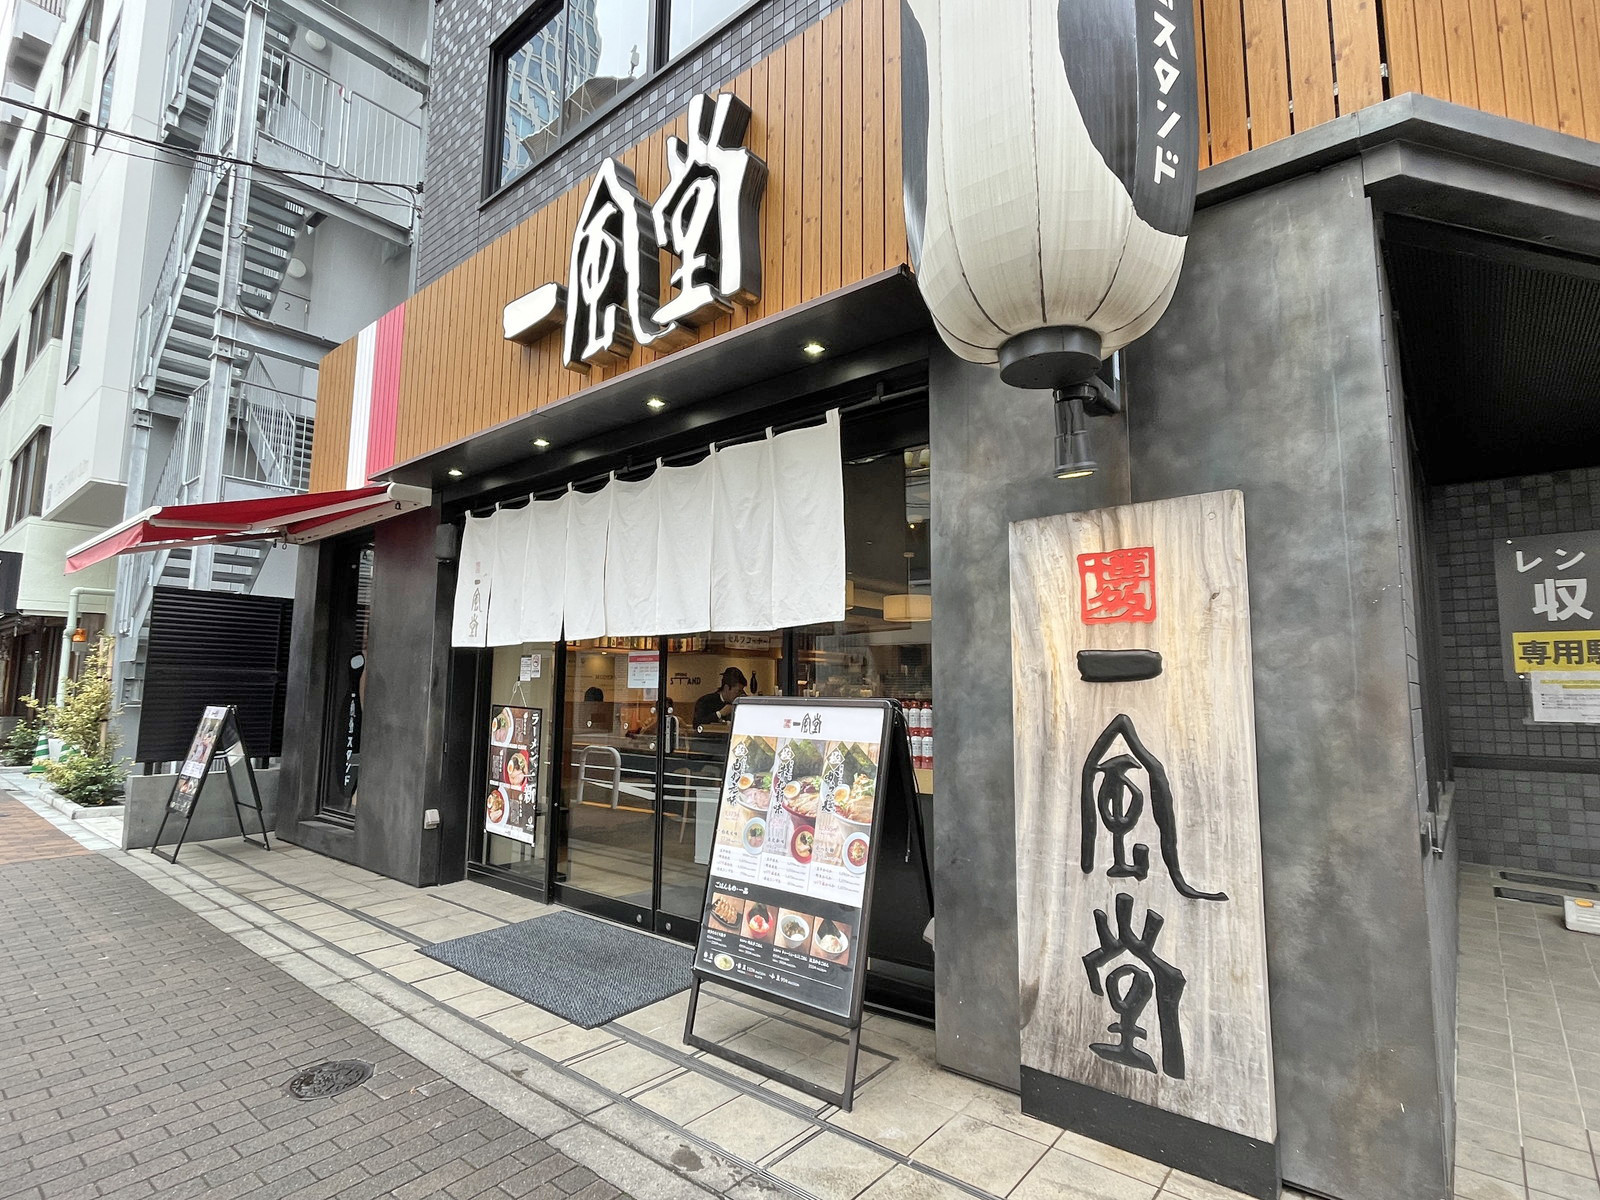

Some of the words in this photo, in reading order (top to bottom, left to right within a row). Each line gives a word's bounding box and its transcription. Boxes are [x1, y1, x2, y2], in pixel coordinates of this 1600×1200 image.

[1153, 0, 1181, 184] スタンド
[503, 93, 748, 371] 一風堂
[1532, 578, 1594, 622] 収
[1077, 649, 1229, 1080] 一風堂
